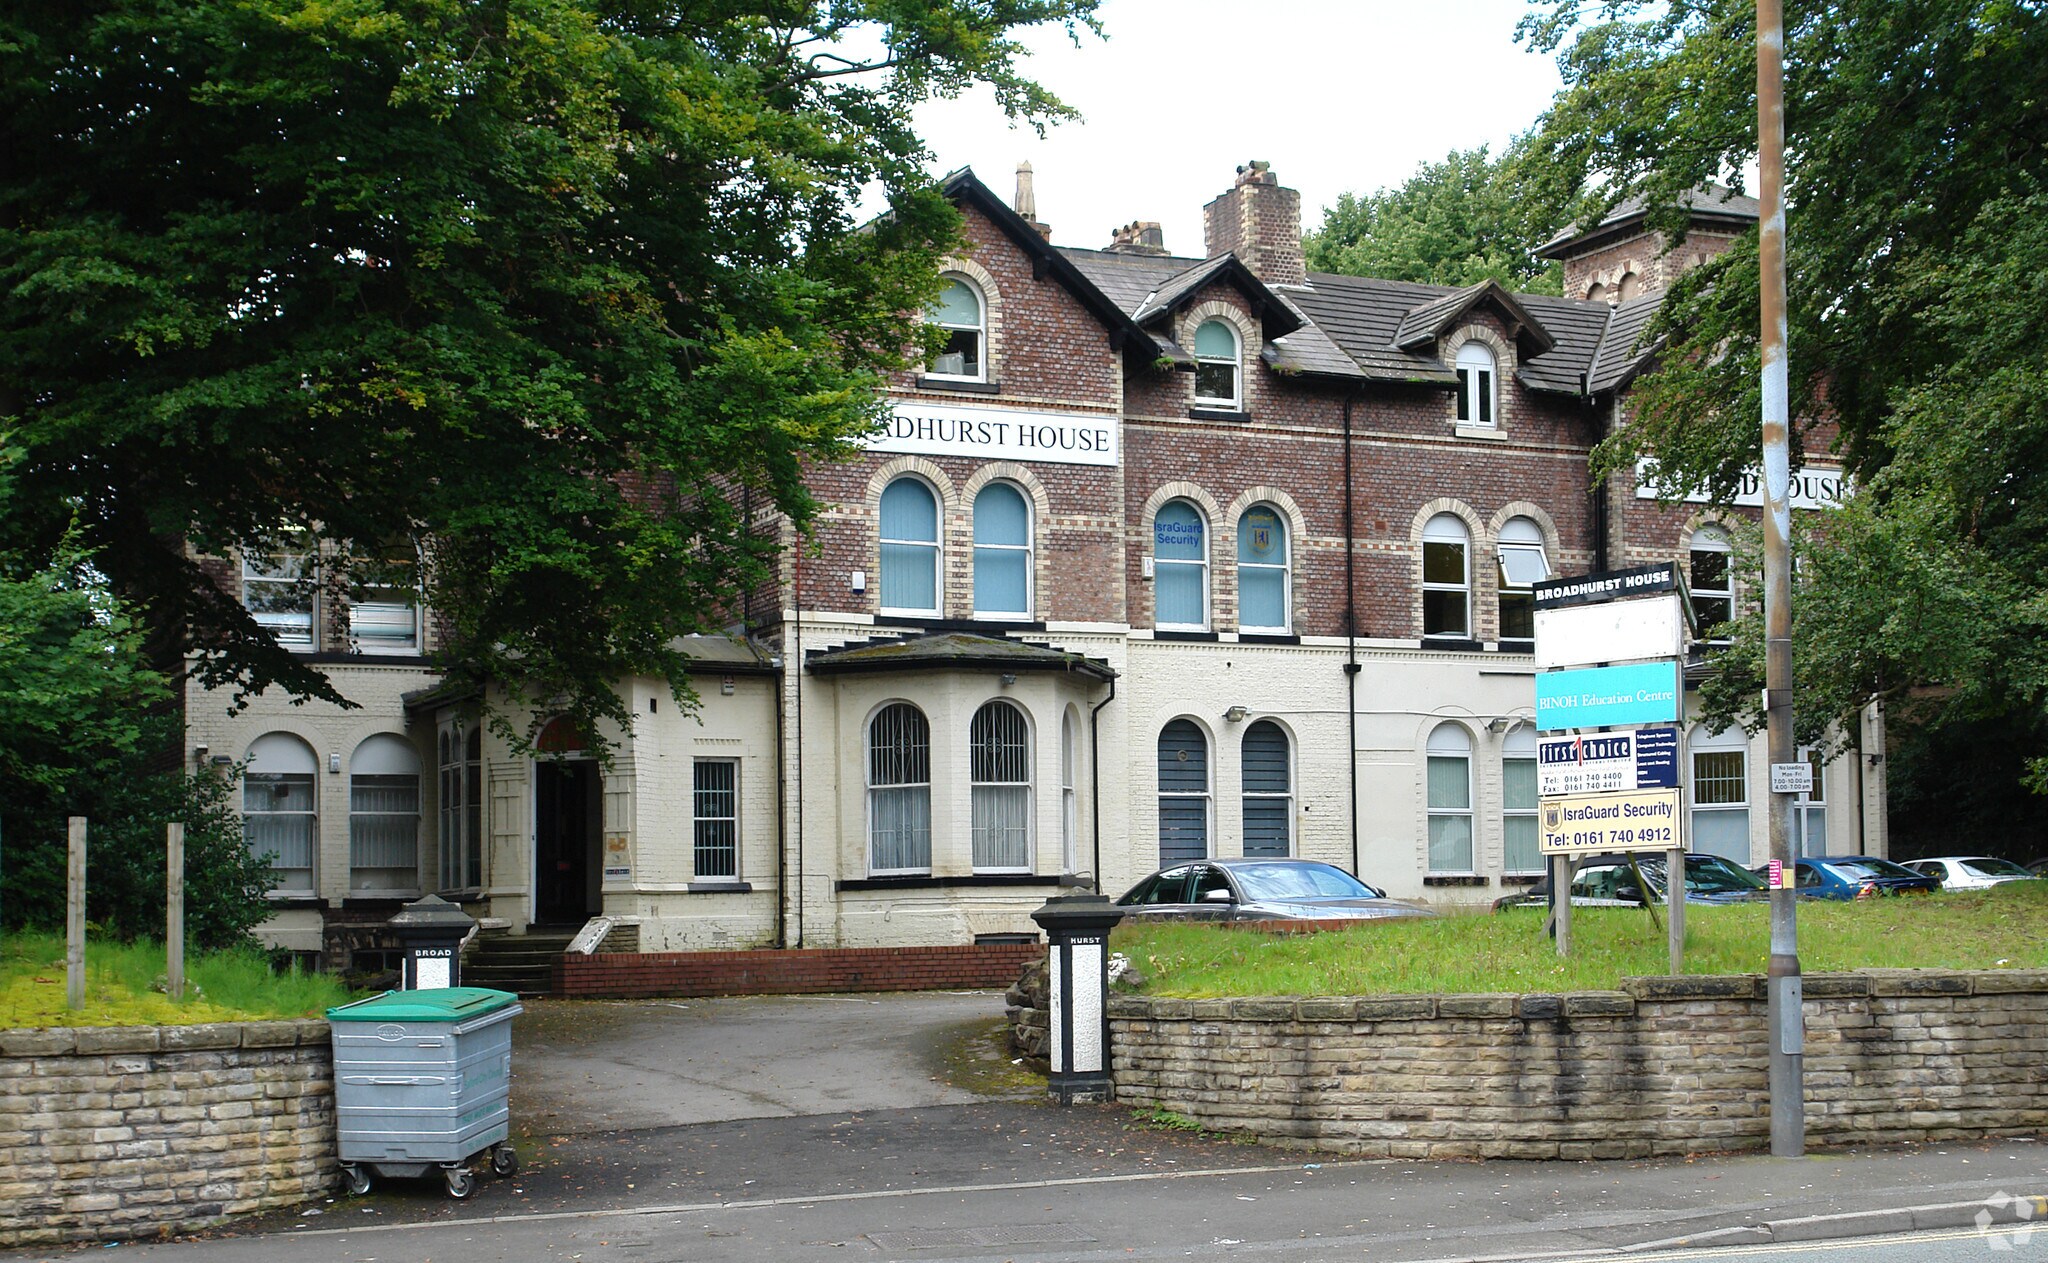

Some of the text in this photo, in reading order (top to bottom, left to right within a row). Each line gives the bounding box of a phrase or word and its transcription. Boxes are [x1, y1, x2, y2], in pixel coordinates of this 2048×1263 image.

[1018, 424, 1109, 452] HOUSE
[1154, 521, 1203, 534] IsraGuard
[1157, 533, 1199, 548] Security
[1536, 570, 1670, 601] BROADHURST HOUSE
[1539, 689, 1673, 710] BINOH Education Centre
[1582, 739, 1628, 759] choice
[1543, 785, 1559, 793] Fax:
[1586, 782, 1600, 790] 740
[1544, 772, 1622, 784] Tel: 0161 740 4400
[1563, 801, 1673, 821] IsraGuard Security
[1546, 827, 1671, 847] Tel: 0161 740 4912
[415, 949, 452, 957] BROAD
